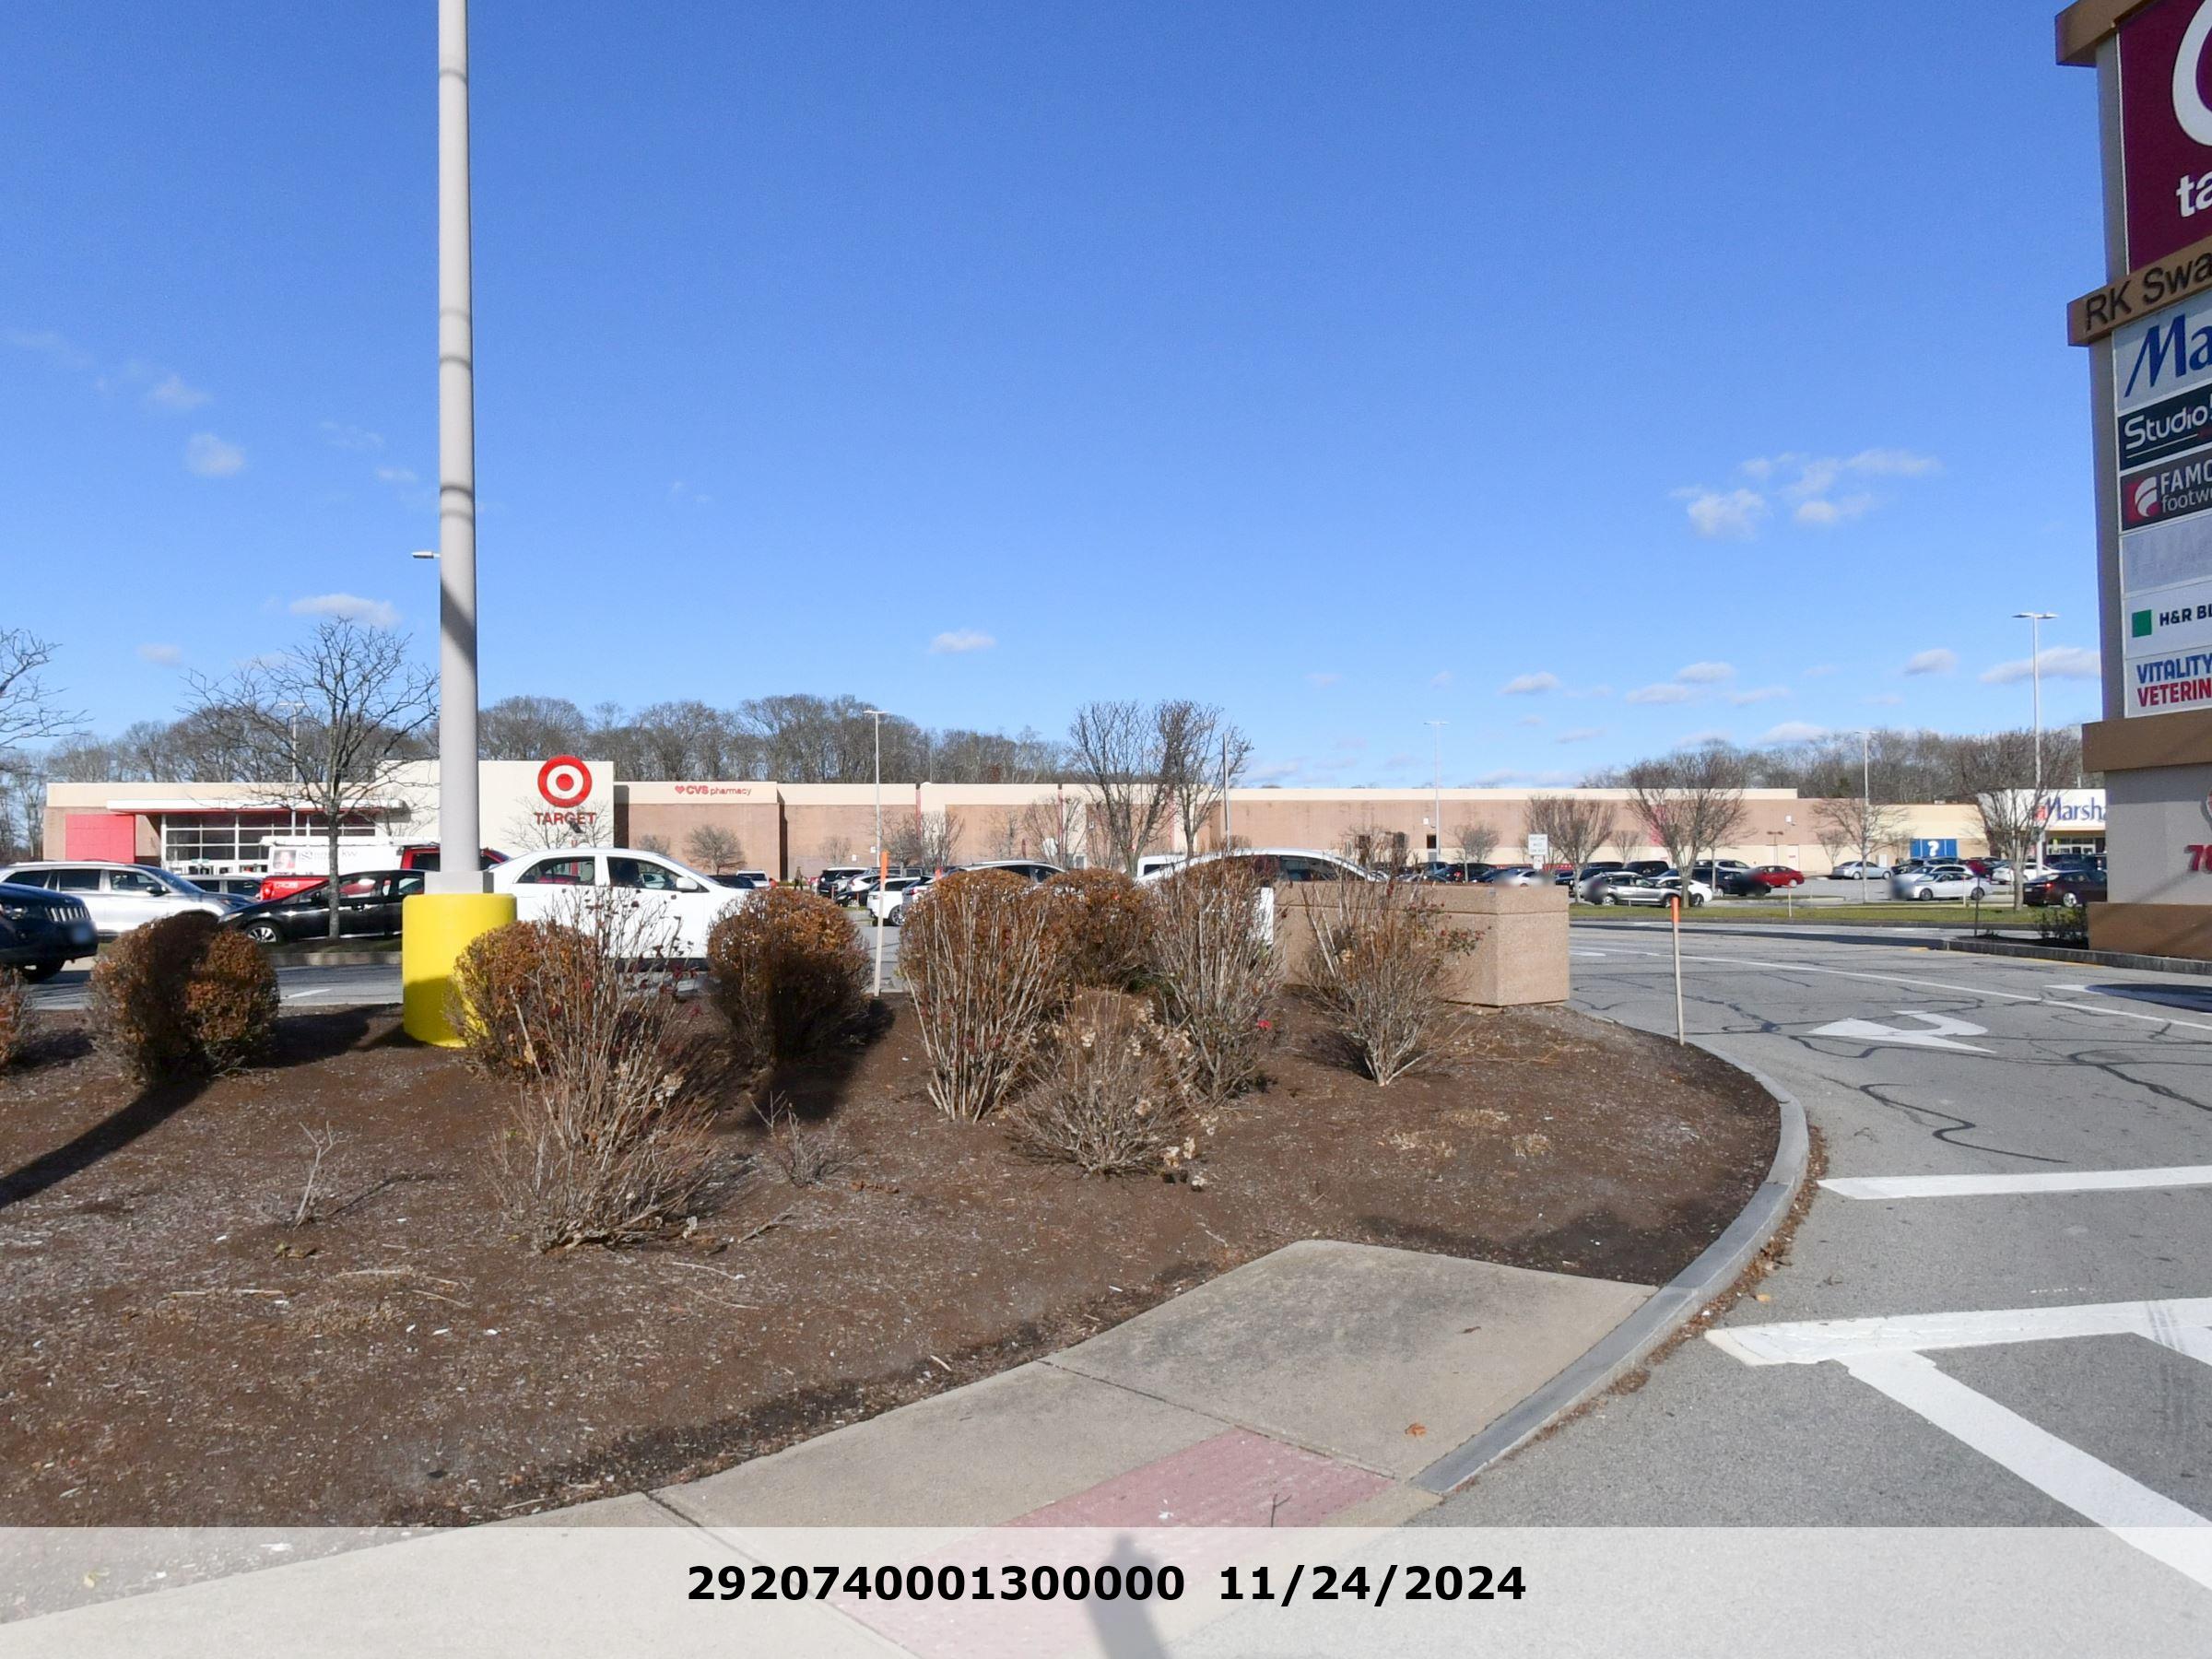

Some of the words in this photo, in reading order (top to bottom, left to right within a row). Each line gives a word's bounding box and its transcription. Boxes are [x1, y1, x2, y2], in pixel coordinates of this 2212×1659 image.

[2085, 280, 2132, 331] RK
[2124, 394, 2212, 450] Studio
[2162, 487, 2212, 513] footw
[2159, 608, 2192, 627] H&R
[2136, 653, 2212, 684] VITALITY
[686, 785, 709, 794] CVS
[710, 787, 752, 796] pharmacy
[533, 812, 597, 826] TARGET
